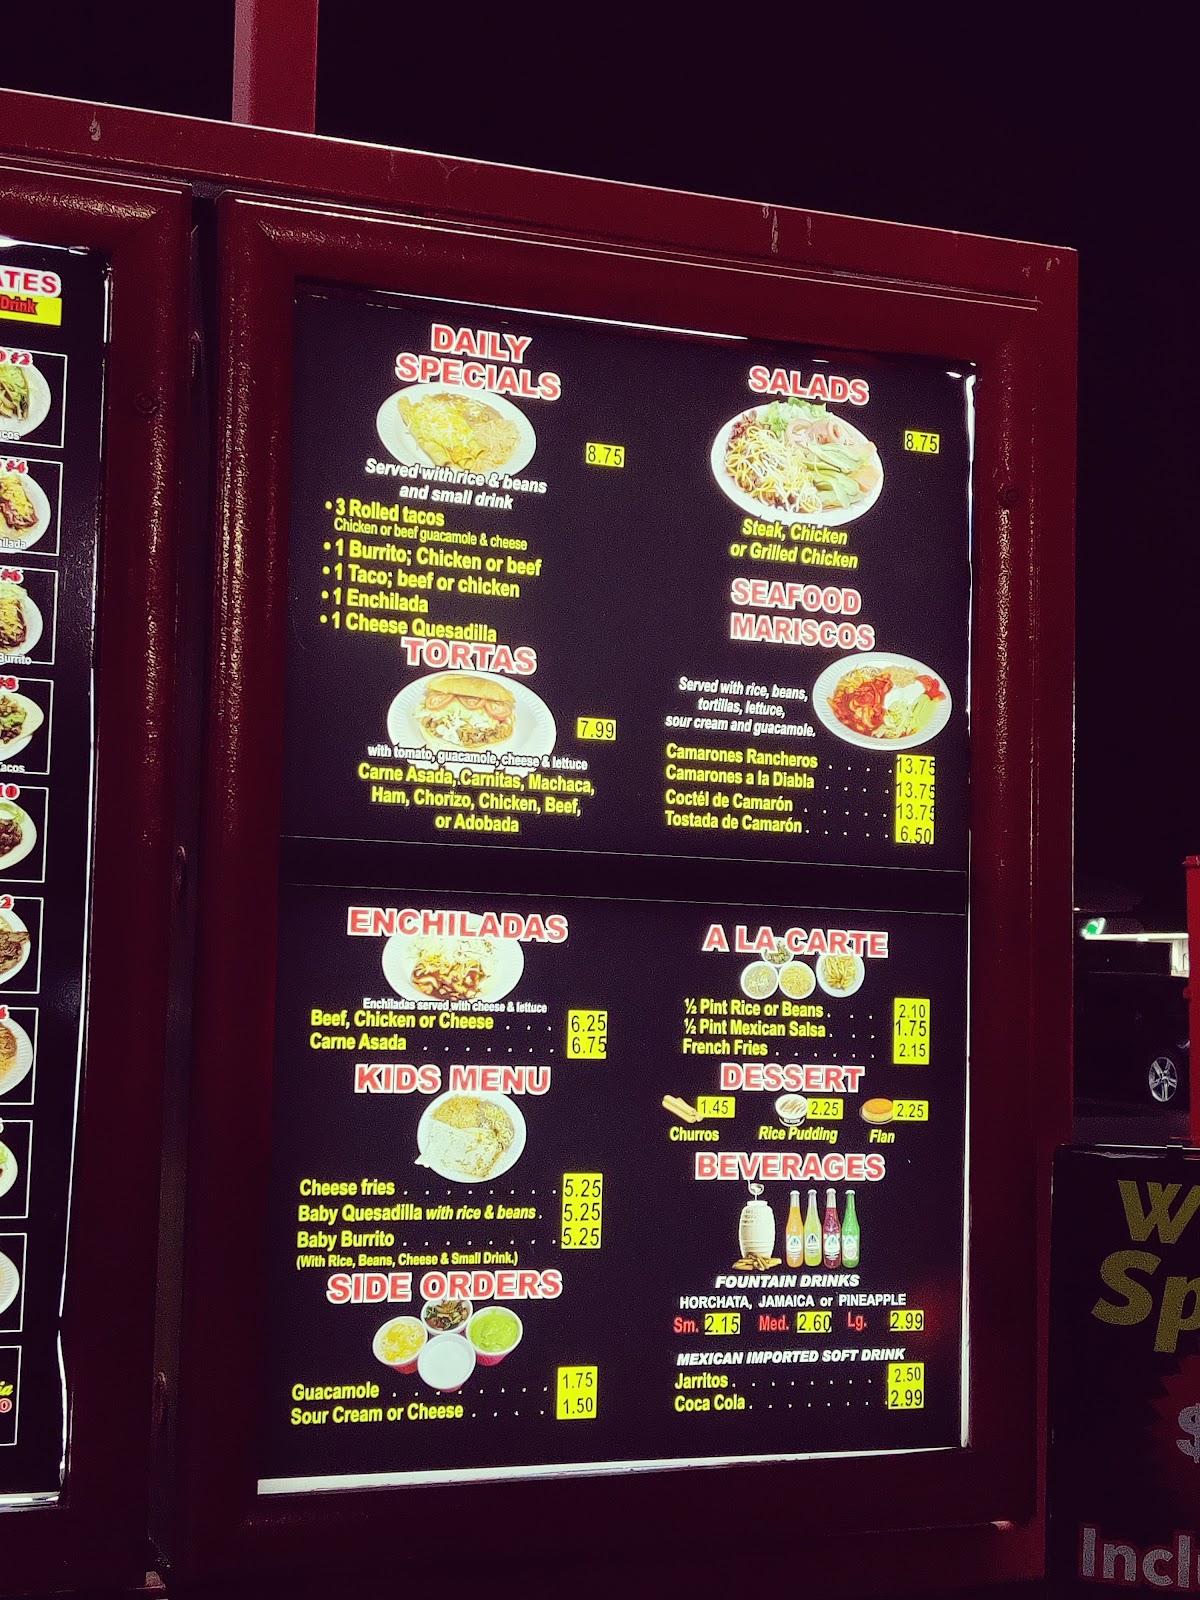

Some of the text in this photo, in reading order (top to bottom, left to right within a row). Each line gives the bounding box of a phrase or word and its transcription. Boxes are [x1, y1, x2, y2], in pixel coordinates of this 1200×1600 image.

[1, 294, 37, 315] Drink
[431, 323, 533, 364] DAILY
[395, 352, 562, 401] SPECIALS
[748, 365, 869, 405] SALADS
[906, 433, 938, 453] 8.75
[588, 445, 622, 466] 8.75
[365, 458, 548, 493] Served rice beans
[432, 488, 514, 509] small drink
[349, 499, 445, 527] Rolled tacos
[334, 517, 528, 550] Chicken beef guacamole cheese
[743, 518, 848, 545] Steak, Chicken
[349, 540, 542, 576] Burrito; Chicken beef
[750, 542, 858, 569] Grilled Chicken
[348, 564, 520, 598] Taco; beef chicken
[347, 588, 429, 613] Enchilada
[730, 577, 861, 615] SEAFOOD
[346, 612, 497, 642] Cheese Quesadilla
[730, 612, 875, 650] MARISCOS
[401, 636, 537, 675] TORTAS
[679, 676, 808, 702] Served rice, beans,
[697, 697, 786, 718] tortillas, lettuce,
[580, 720, 614, 739] 7.99
[665, 714, 816, 738] sour cream guacamole.
[393, 747, 588, 770] tomato, guacamole, cheese lettuce
[666, 743, 818, 768] Camarones Rancheros
[665, 764, 815, 789] Camarones Diabla
[897, 757, 936, 777] 13.75
[358, 762, 595, 795] Carne Asada, Carnitas, Machaca,
[665, 788, 794, 812] Coctél Camarón
[896, 781, 935, 799] 13.75
[371, 786, 582, 816] Ham, Chorizo, Chicken, Beef,
[665, 810, 802, 833] Tostada Camarón
[897, 803, 935, 821] 13.75
[454, 814, 519, 833] Adobada
[900, 826, 932, 843] 6.50
[347, 906, 569, 943] ENCHILADAS
[702, 924, 888, 958] A LA CARTE
[363, 997, 547, 1014] Enchiladas served cheese lettuce
[700, 998, 824, 1018] Pint Rice Beans
[899, 1004, 926, 1018] 2.10
[310, 1009, 494, 1030] Beef, Chicken Cheese
[571, 1015, 606, 1032] 6.25
[700, 1018, 826, 1038] Pint Mexican Salsa
[896, 1020, 927, 1036] 1.75
[310, 1032, 407, 1051] Carne Asada
[572, 1036, 607, 1054] 6.75
[683, 1038, 768, 1056] French Fries
[899, 1043, 926, 1058] 2.15
[354, 1063, 551, 1095] KIDS MENU
[720, 1062, 865, 1093] DESSERT
[701, 1100, 729, 1114] 1.45
[811, 1102, 840, 1116] 2.25
[897, 1104, 924, 1118] 2.25
[670, 1126, 720, 1142] Churros
[758, 1126, 838, 1144] Rice Pudding
[870, 1129, 896, 1144] Flan
[695, 1152, 886, 1182] BEVERAGES
[300, 1179, 395, 1197] Cheese fries
[564, 1179, 601, 1198] 5.25
[298, 1205, 339, 1225] Baby
[341, 1204, 422, 1222] Quesadilla
[456, 1206, 481, 1220] rice
[563, 1203, 601, 1222] 5.25
[297, 1230, 394, 1251] Baby Burrito
[562, 1227, 600, 1247] 5.25
[296, 1252, 481, 1270] (With Rice, Beans, Cheese Small
[326, 1269, 563, 1305] SIDE ORDERS
[715, 1274, 860, 1288] FOUNTAIN DRINKS
[680, 1293, 906, 1309] HORCHATA, JAMAICA PINEAPPLE
[674, 1316, 699, 1333] Sm.
[705, 1315, 740, 1334] 2.15
[759, 1315, 789, 1332] Med.
[798, 1314, 832, 1332] 2.60
[848, 1312, 867, 1330] Lg.
[891, 1312, 923, 1330] 2.99
[676, 1348, 906, 1366] MEXICAN IMPORTED SOFT DRINK
[562, 1372, 593, 1388] 1.75
[674, 1372, 728, 1390] Jarritos
[894, 1367, 922, 1383] 2.50
[292, 1382, 380, 1401] Guacamole
[891, 1390, 922, 1406] 2.99
[563, 1397, 593, 1414] 1.50
[674, 1394, 745, 1412] Coca Cola
[291, 1403, 464, 1425] Sour Cream Cheese
[1082, 1527, 1200, 1588] Incl
